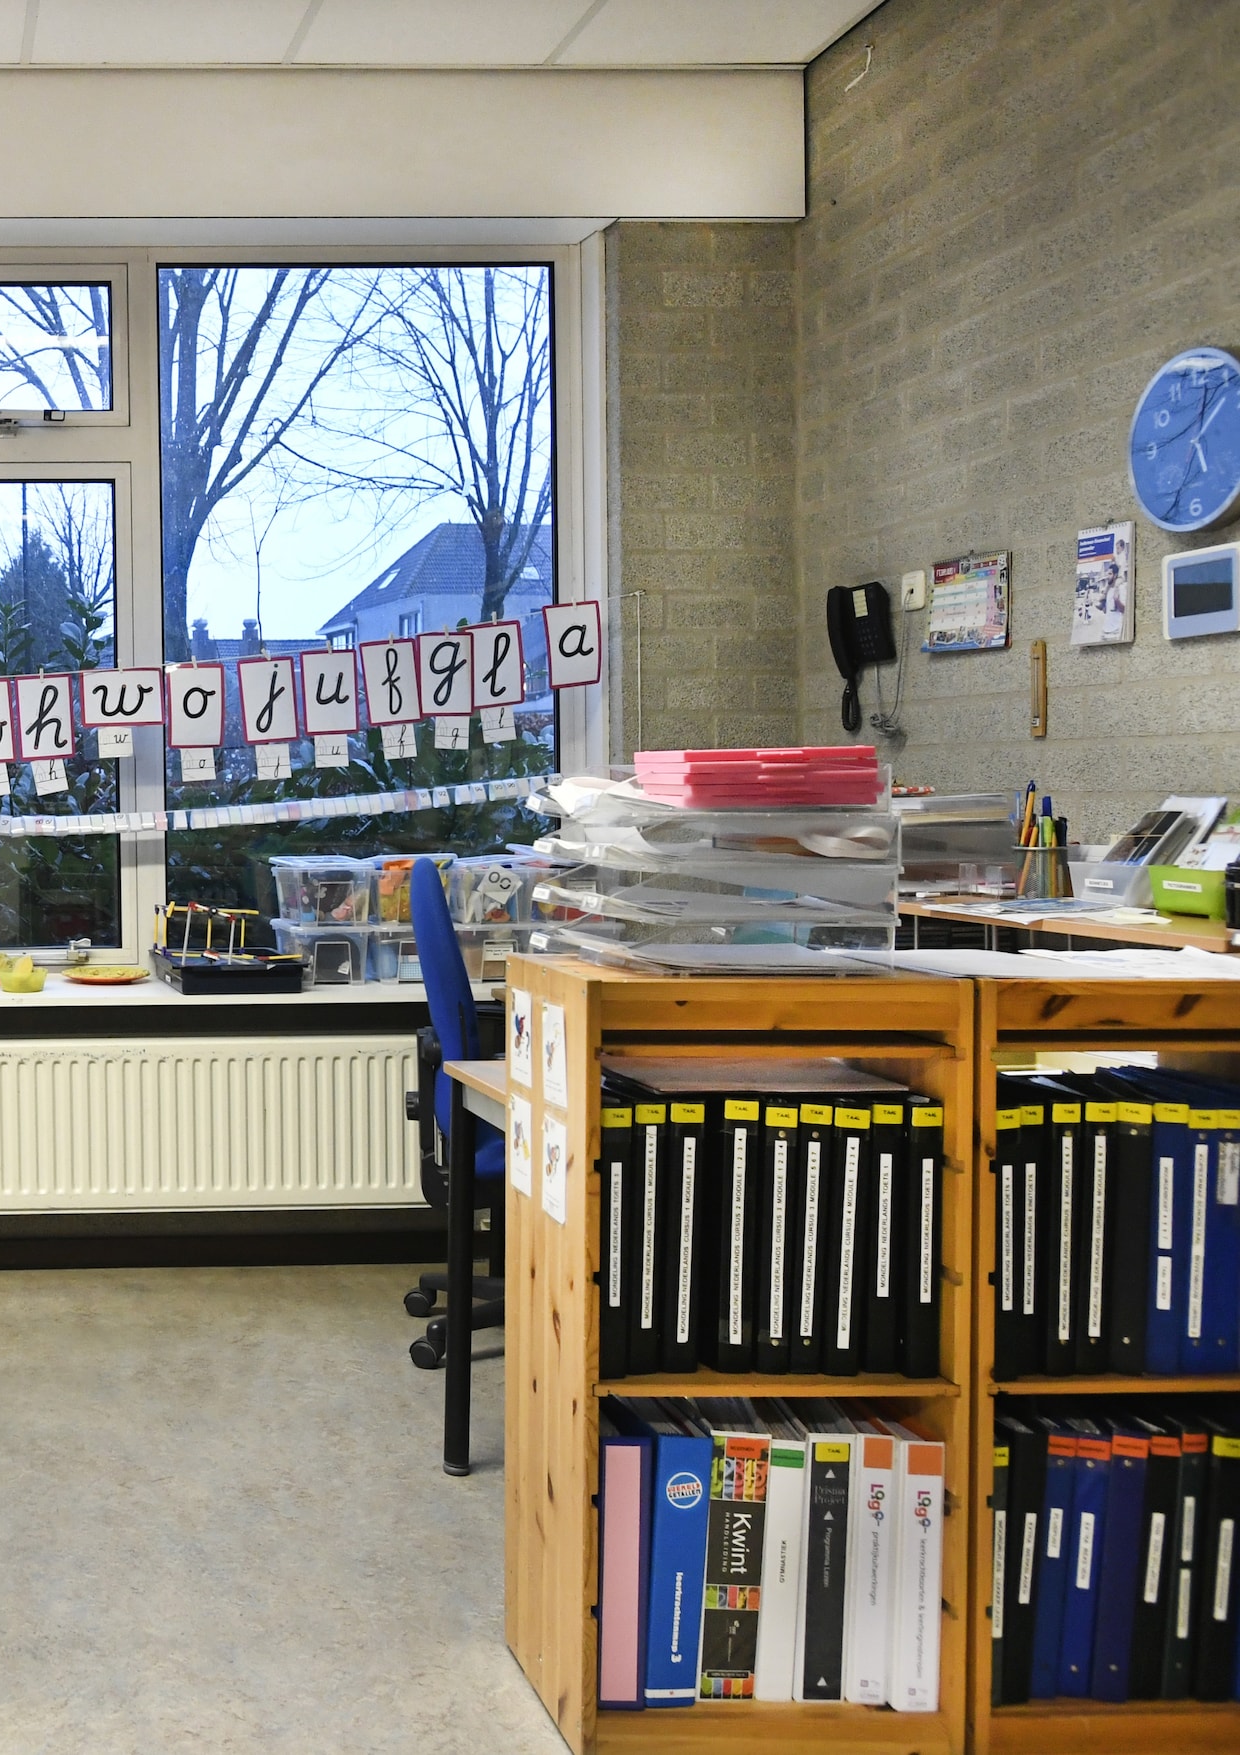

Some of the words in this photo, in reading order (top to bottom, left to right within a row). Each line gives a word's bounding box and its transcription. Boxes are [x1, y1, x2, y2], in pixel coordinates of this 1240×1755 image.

[1168, 383, 1181, 401] 11
[1154, 409, 1170, 429] 10
[1189, 499, 1202, 516] 6
[558, 624, 594, 658] a
[380, 648, 402, 715] f
[429, 640, 467, 707] g
[481, 632, 511, 698] l
[92, 683, 154, 717] w
[182, 686, 216, 719] o
[256, 663, 282, 733] j
[315, 671, 350, 705] u
[25, 685, 67, 750] h
[499, 707, 504, 728] l
[114, 734, 128, 744] w
[332, 746, 340, 755] u
[398, 724, 407, 757] f
[452, 728, 459, 748] g
[49, 758, 57, 780] h
[199, 759, 206, 768] o
[722, 1511, 730, 1573] HANDLEIDING
[730, 1511, 752, 1575] Kwint
[779, 1540, 787, 1583] GYMNASTIEK
[670, 1653, 682, 1663] 3
